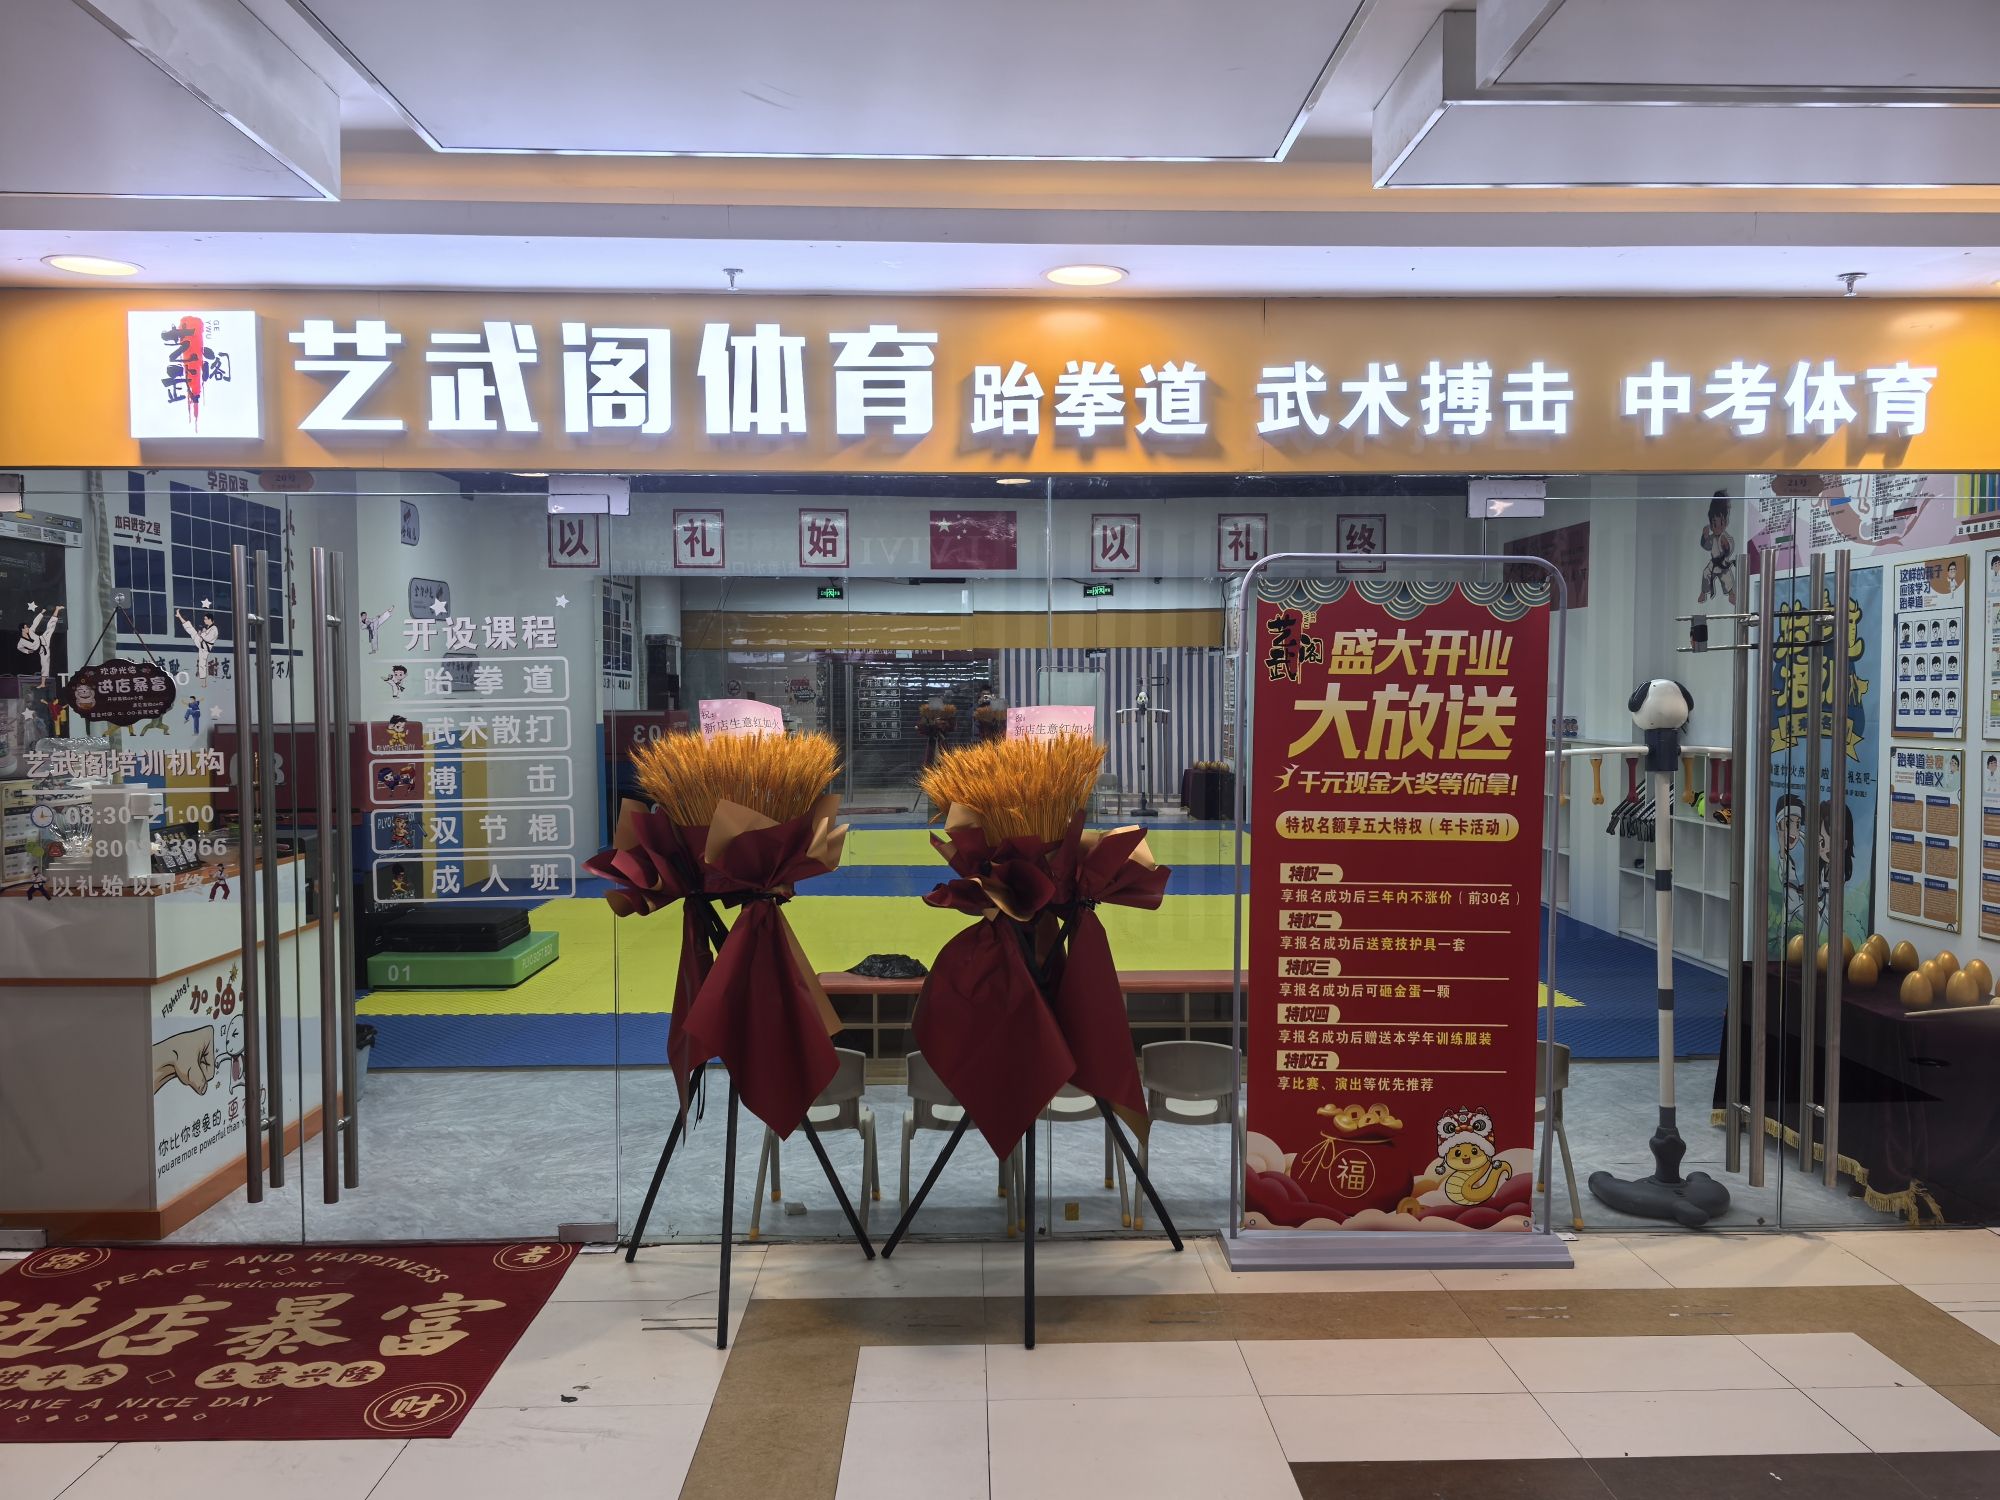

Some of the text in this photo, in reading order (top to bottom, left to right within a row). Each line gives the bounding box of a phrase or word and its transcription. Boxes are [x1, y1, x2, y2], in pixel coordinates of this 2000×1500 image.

[288, 320, 938, 435] 艺武阁体育
[970, 361, 1938, 438] 跆拳道 武术搏击 中考体育
[114, 514, 162, 536] 本月进步之星
[558, 517, 839, 558] 以 礼 始
[1101, 525, 1131, 562] 以
[1228, 523, 1258, 562] 礼
[403, 615, 559, 651] 开设课程
[1328, 628, 1514, 676] 盛大开业
[97, 676, 168, 695] 进店暴富
[424, 665, 553, 695] 跆拳道
[425, 714, 554, 746] 武术散打
[703, 716, 781, 735] 新店生意红如火
[1014, 722, 1093, 737] 新店生意红如火
[1287, 682, 1518, 761] 大放送
[22, 747, 225, 779] 艺武阁培训机构
[427, 764, 556, 796] 搏击
[1298, 770, 1518, 796] 千元现金大奖等你拿!
[1915, 771, 1945, 788] 的意义
[429, 813, 559, 845] 双节棍
[52, 874, 124, 898] 以礼始
[431, 863, 559, 894] 成人班
[1288, 865, 1334, 882] 特权一
[1287, 912, 1332, 929] 特权二
[1279, 935, 1466, 952] 享报名成功后送竞技护具一套
[387, 964, 411, 982] 01
[1285, 959, 1331, 976] 特权三
[161, 976, 190, 1019] Fighting!
[190, 976, 236, 1020] 加油
[1279, 982, 1451, 999] 享报名成功后可砸金蛋一颗
[1284, 1005, 1330, 1023] 特权四
[1278, 1029, 1492, 1046] 享报名成功后赠送本学年训练服装
[1283, 1052, 1329, 1070] 特权五
[1277, 1075, 1434, 1092] 享比赛、演出等优先推荐
[181, 1146, 198, 1162] more
[199, 1127, 226, 1154] powerful
[226, 1121, 240, 1135] than
[1337, 1156, 1366, 1192] 福
[513, 1245, 552, 1264] 者
[92, 1252, 452, 1292] PEACE AND HAPPINESS
[216, 1276, 323, 1290] welcome
[0, 1293, 506, 1361] 进店暴富
[204, 1364, 377, 1387] 生意兴隆
[0, 1396, 273, 1410] AVE A NICE DAY
[389, 1391, 444, 1421] 财
